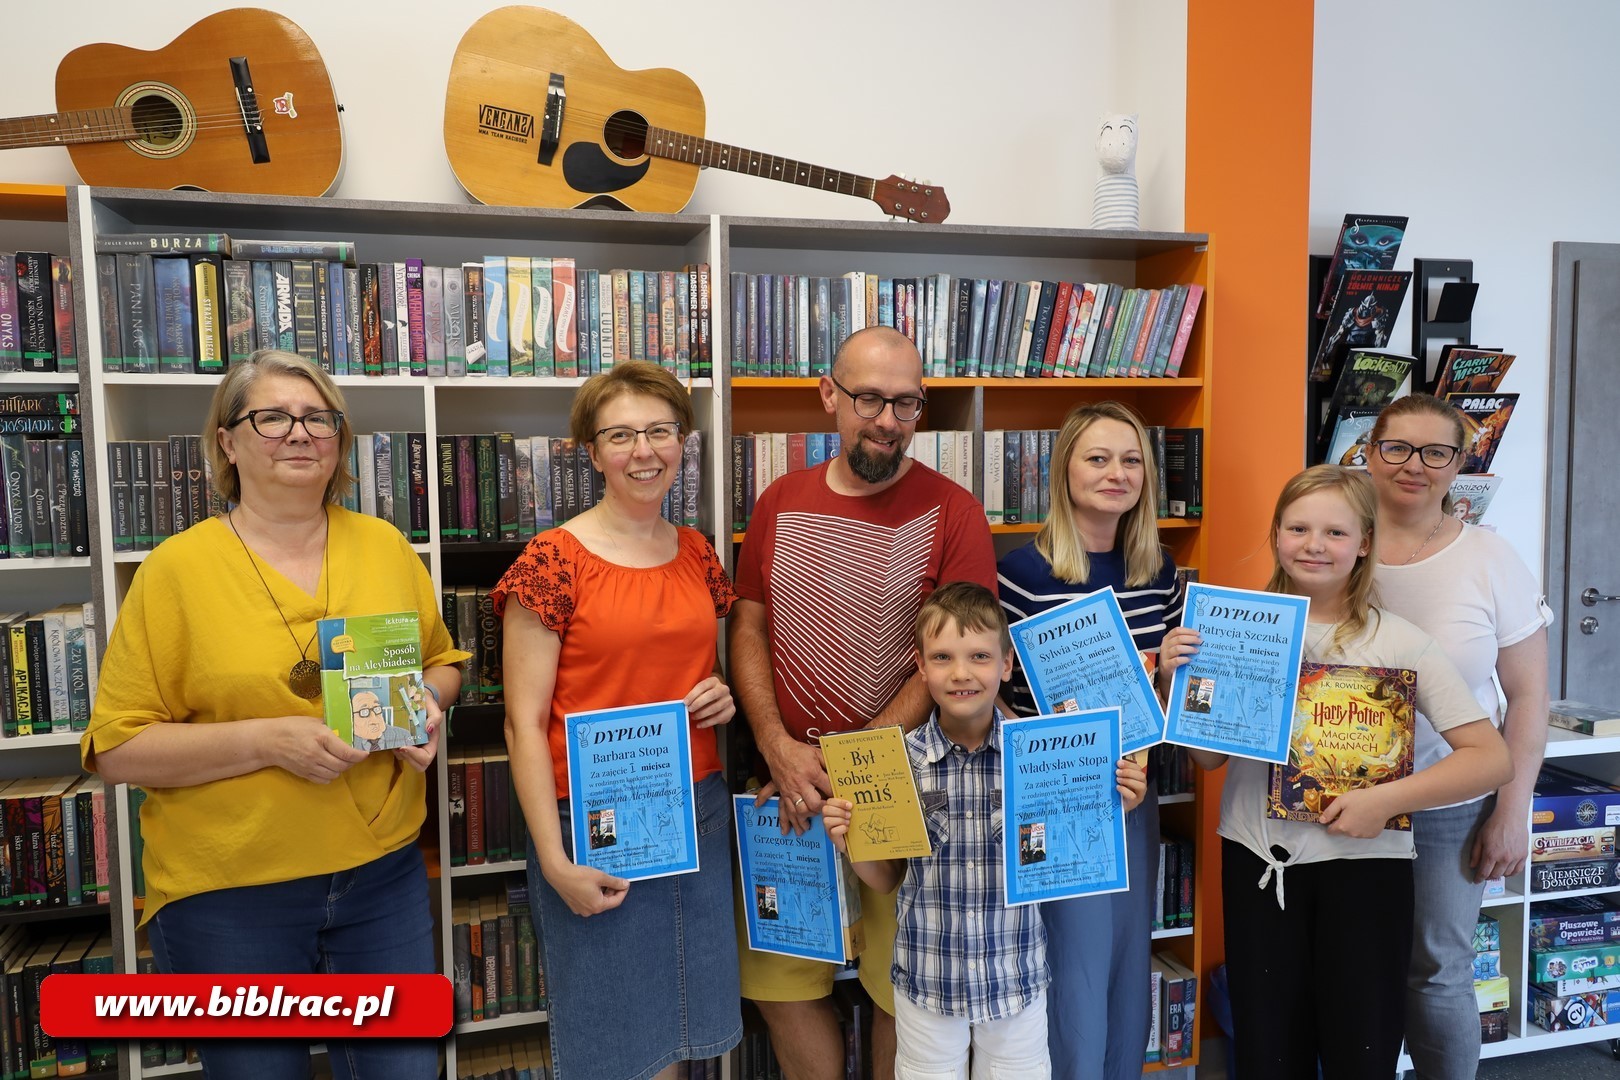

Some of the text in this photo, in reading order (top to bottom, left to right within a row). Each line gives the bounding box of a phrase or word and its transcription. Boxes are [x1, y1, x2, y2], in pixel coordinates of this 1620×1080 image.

[150, 238, 202, 248] BURZA
[1350, 274, 1402, 283] WOJOWNICZE
[1376, 283, 1400, 291] NINJA
[275, 271, 292, 333] ARMADA
[408, 288, 423, 333] NEVERMORE
[960, 290, 968, 313] ZEUS
[27, 300, 36, 347] KRÓLOWYCH
[36, 295, 46, 352] WOJNA DWÓCH
[130, 283, 144, 349] PANI NOC
[1, 313, 13, 348] ONYKS
[203, 298, 214, 361] STRAŻNIK MIECZA
[601, 312, 612, 358] LUONTO
[1034, 338, 1044, 360] ŚWIT
[1353, 356, 1391, 372] LOCKE
[1452, 356, 1498, 371] CZARNY
[1453, 365, 1489, 382] MŁOT
[1462, 398, 1505, 410] PAŁAC
[441, 443, 452, 486] LUMINARIUSZE
[499, 454, 507, 499] ESCHBACH
[554, 464, 562, 510] ANGELFALL
[567, 468, 575, 509] ANGELFALL
[686, 468, 696, 519] KLEJNOT
[10, 471, 23, 535] ONYX IVORY
[36, 495, 44, 519] ODWET
[58, 489, 67, 542] PRZEBUDZENIE
[1209, 605, 1280, 625] DYPLOM
[1037, 613, 1098, 645] DYPLOM
[1198, 623, 1288, 645] Patrycja Szczuka
[384, 645, 415, 657] Sposób
[1039, 630, 1112, 663] Sylwia Szczuka
[1210, 642, 1280, 658] zajęcie miejsca
[49, 629, 64, 696] KRÓLOWA NICZEGO
[364, 656, 416, 672] Alcybiadesa
[1044, 645, 1116, 675] Za zajęcie miejsca
[72, 648, 84, 694] ZŁY KRÓL
[15, 669, 29, 720] APLIKACJA
[1335, 682, 1372, 691] ROWLING
[1311, 702, 1386, 731] Harry Potter
[594, 722, 663, 744] DYPLOM
[857, 735, 883, 743] PUCHATEK
[1027, 732, 1096, 754] DYPLOM
[1322, 730, 1376, 741] MAGICZNY
[592, 746, 669, 764] Barbara Stopa
[1316, 740, 1378, 753] ALMANACH
[850, 749, 876, 769] Był
[1019, 755, 1109, 775] Władysław Stopa
[590, 762, 671, 779] Za zajęcie miejsca
[838, 772, 873, 787] sobie
[1024, 774, 1101, 791] Za zajęcie miejsca
[854, 783, 893, 804] miś
[65, 801, 74, 826] DZIENNIK
[15, 835, 23, 850] iskra
[32, 832, 40, 849] blizna
[754, 834, 821, 849] Grzegorz Stopa
[1534, 835, 1595, 849] CYWILIZACJA
[796, 855, 820, 863] miejsca
[1539, 866, 1605, 881] TAJEMNICZE
[1542, 876, 1602, 889] DOMOSTWO
[1559, 920, 1599, 930] Pluszowe
[1561, 927, 1604, 939] Opowieści
[1570, 1007, 1583, 1020] CV
